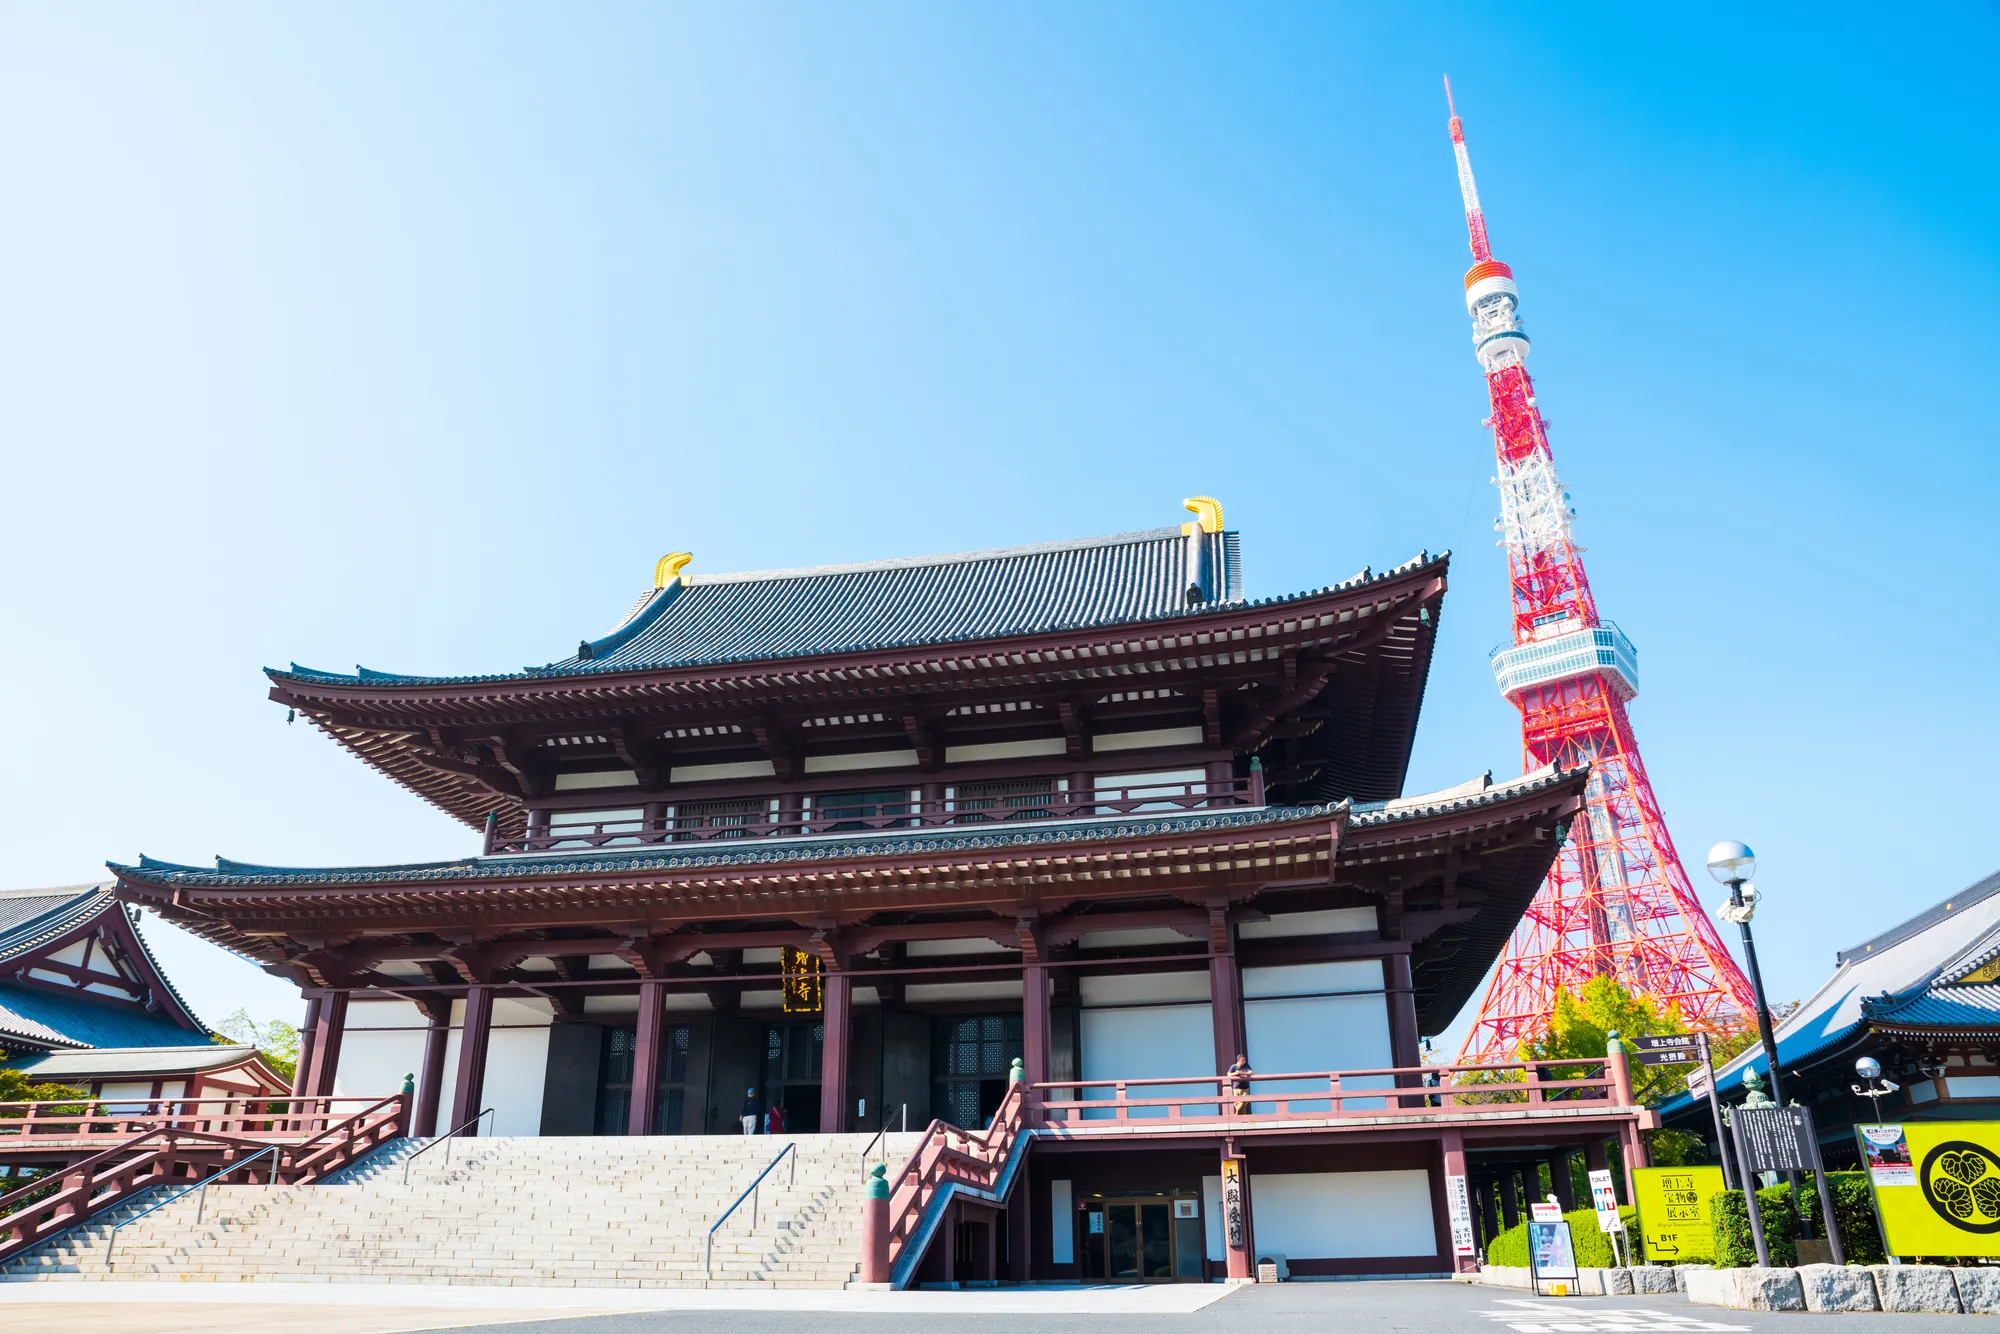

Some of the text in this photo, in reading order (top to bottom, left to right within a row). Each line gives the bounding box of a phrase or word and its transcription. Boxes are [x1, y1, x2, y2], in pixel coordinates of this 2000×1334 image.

[1650, 1037, 1690, 1047] 増上寺会館
[1659, 1052, 1686, 1061] 光摂殿
[1591, 1175, 1610, 1183] TOILET
[1662, 1178, 1694, 1189] 増上寺
[1664, 1192, 1686, 1204] 宝物
[1226, 1168, 1242, 1240] 大殿受付
[1666, 1206, 1700, 1218] 展示室
[1660, 1234, 1678, 1242] B1F
